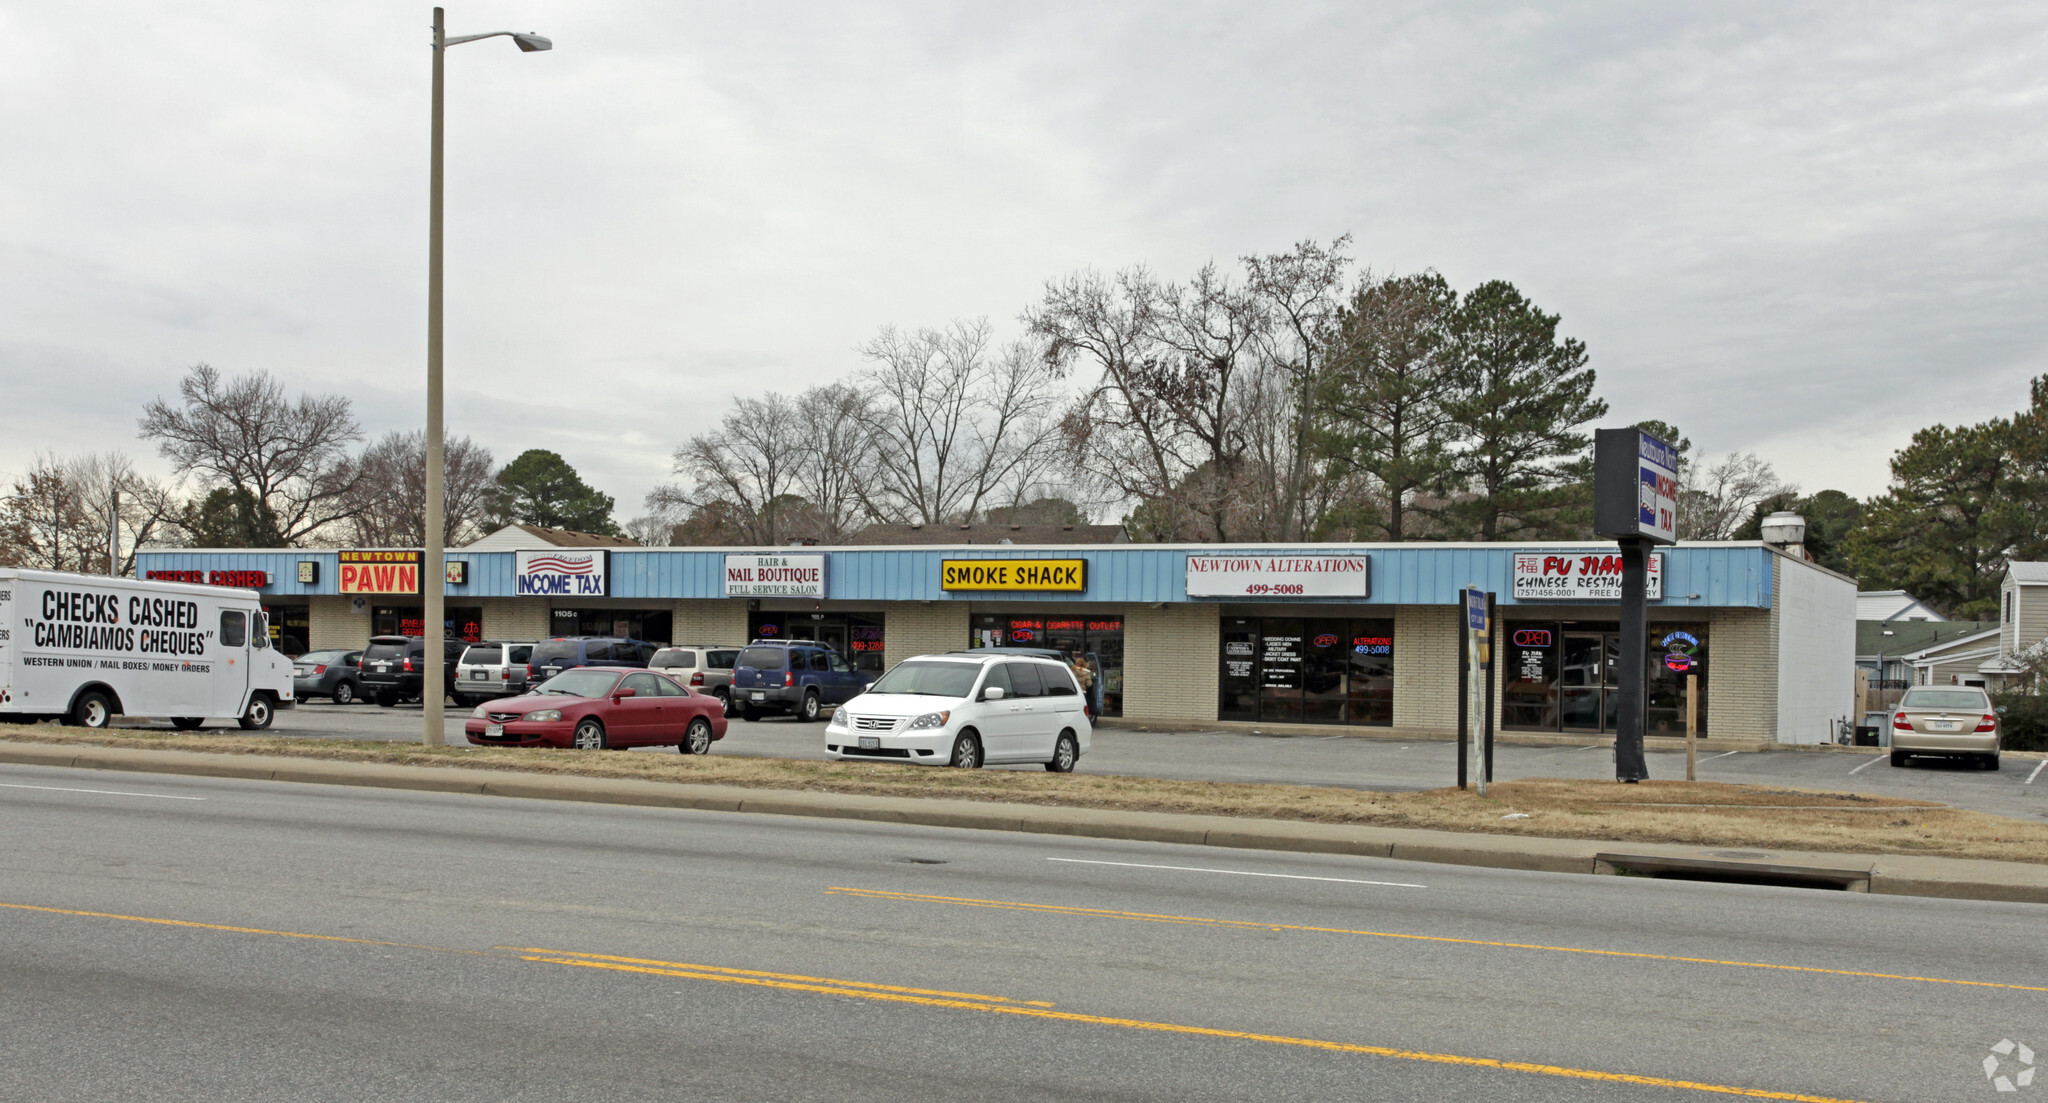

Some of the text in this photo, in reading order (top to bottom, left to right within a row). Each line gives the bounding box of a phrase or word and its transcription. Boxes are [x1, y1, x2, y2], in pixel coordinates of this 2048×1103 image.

[1656, 473, 1676, 503] INCOME
[1661, 507, 1672, 532] TAX
[342, 552, 416, 561] NEWTOWN
[757, 558, 788, 566] HAIR &
[1190, 557, 1364, 573] NEWTOWN ALTERATIONS
[1517, 557, 1538, 573] 福
[1543, 556, 1572, 576] FU
[209, 570, 265, 587] CASHED
[342, 565, 415, 592] PAWN
[728, 568, 819, 583] NAIL BOUTIQUE
[945, 566, 1077, 584] SMOKE SHACK
[1516, 577, 1659, 588] CHINESE RESTAUNT
[518, 574, 602, 594] INCOME TAX
[729, 585, 818, 594] FULL SERVICE SALON
[1246, 584, 1304, 595] 499-5008
[1517, 589, 1576, 597] (757)456-0001
[42, 590, 198, 629] CHECKS CASHED
[554, 610, 573, 618] 1105
[759, 625, 778, 635] OPEN
[1011, 620, 1033, 629] CIGAR
[1046, 621, 1084, 629] CIGARETTE
[1089, 622, 1120, 630] OUTLET
[25, 618, 214, 656] "CAMBIAMOS CHEQUES"
[1012, 630, 1034, 640] OPEN
[1313, 636, 1338, 645] OPEN
[1353, 637, 1392, 645] ALTERATIONS
[1514, 630, 1550, 645] OPEN
[1355, 645, 1390, 654] 499-5008
[23, 657, 64, 667] WESTERN
[67, 659, 92, 668] UNION
[100, 660, 120, 670] MAIL
[152, 663, 179, 672] MONEY
[181, 663, 210, 673] ORDERS
